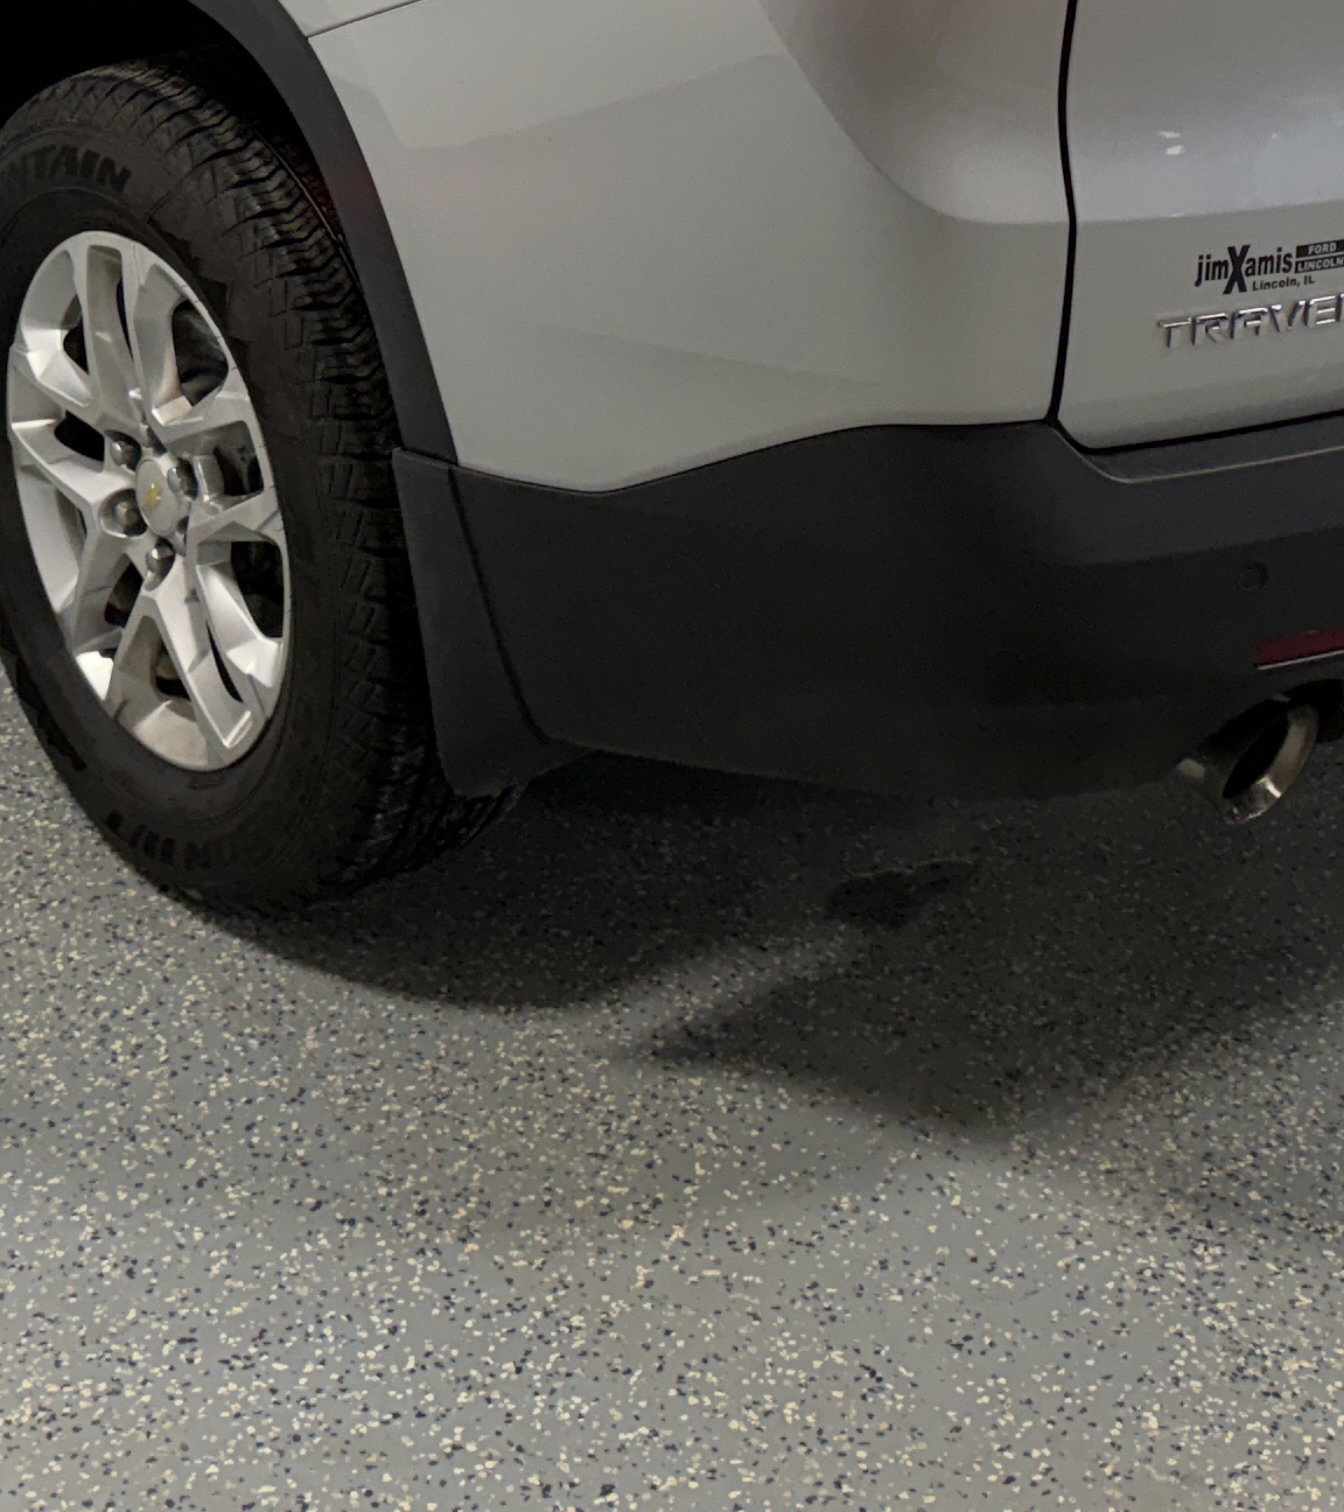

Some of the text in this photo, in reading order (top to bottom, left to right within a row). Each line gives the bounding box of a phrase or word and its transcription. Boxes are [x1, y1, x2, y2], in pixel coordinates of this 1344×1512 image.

[1307, 241, 1337, 255] FORD
[1296, 256, 1344, 273] LINCOLN
[1251, 274, 1315, 291] Lincoln, IL
